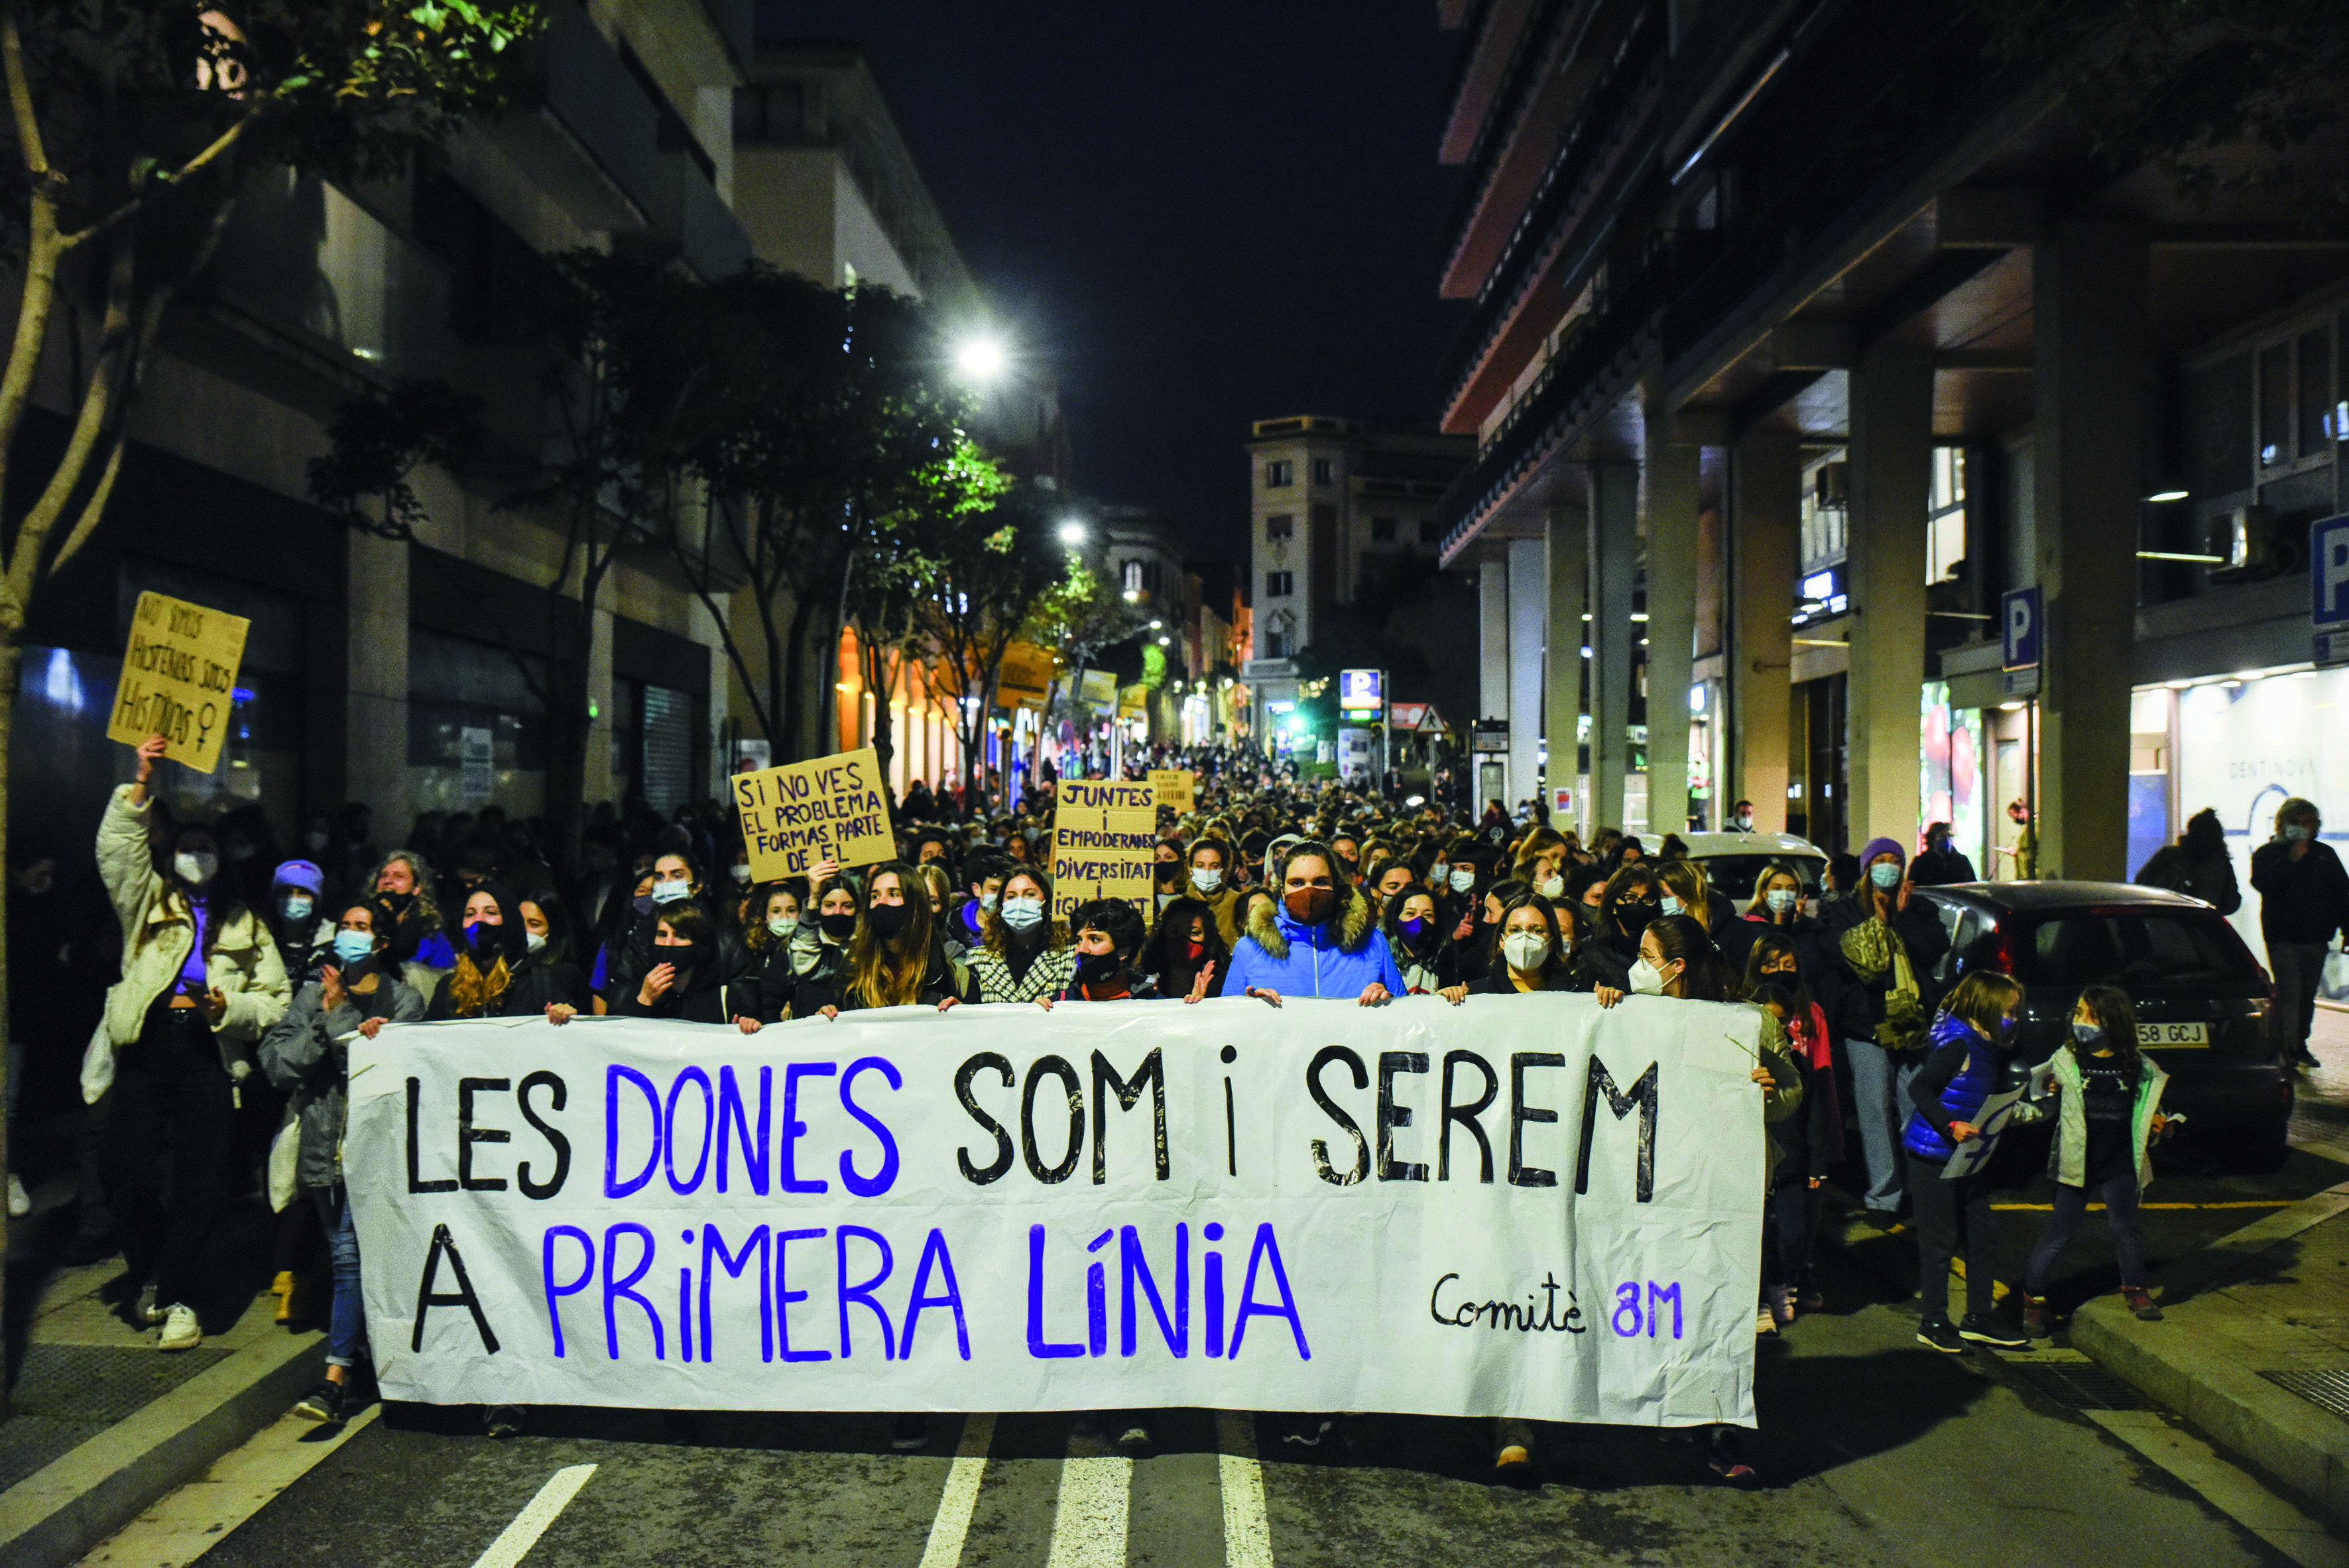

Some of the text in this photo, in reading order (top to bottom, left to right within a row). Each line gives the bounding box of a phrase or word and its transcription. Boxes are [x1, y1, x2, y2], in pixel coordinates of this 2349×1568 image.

[2324, 528, 2349, 612] P
[2009, 599, 2031, 660] P
[1351, 672, 1371, 697] P
[777, 775, 809, 802] NO
[815, 762, 863, 795] VES
[1062, 785, 1154, 807] JUNTES
[743, 790, 882, 835] EL PROBLEMA
[1103, 810, 1107, 831] i
[756, 814, 884, 855] FORMAS PARTE
[787, 849, 810, 873] DE
[2167, 1025, 2201, 1042] GCJ
[406, 1044, 1659, 1203] LES DONES SOM i SEREM
[411, 1223, 501, 1355] A
[1431, 1272, 1683, 1339] Comitè 8M
